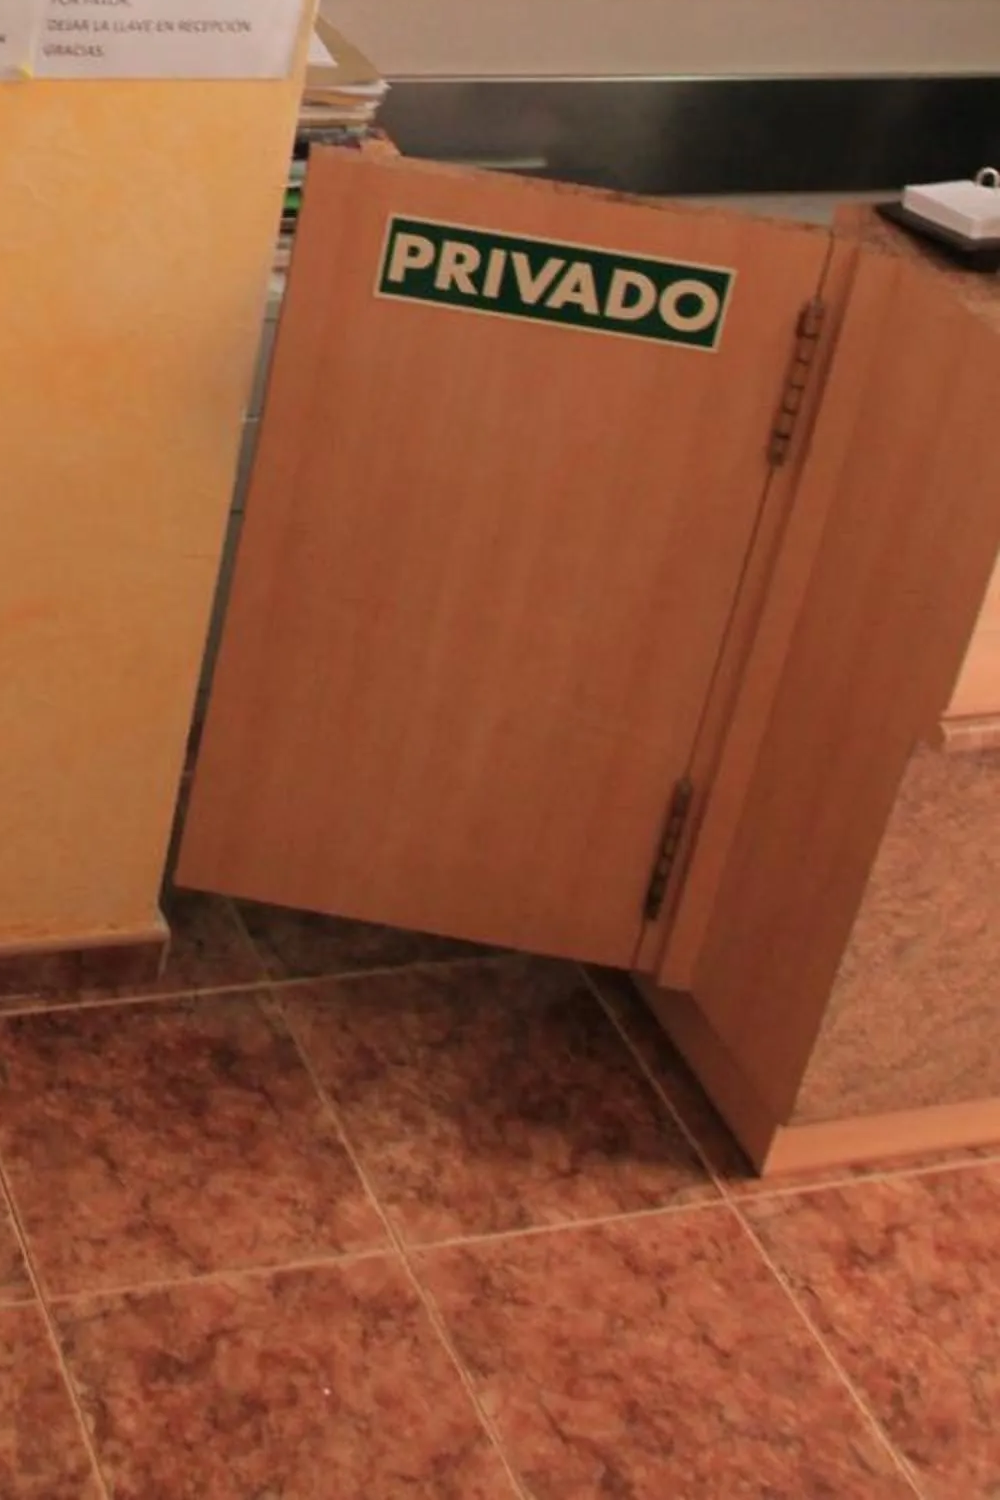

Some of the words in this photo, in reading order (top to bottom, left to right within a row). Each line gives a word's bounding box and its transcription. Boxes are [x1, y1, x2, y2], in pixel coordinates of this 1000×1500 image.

[47, 19, 89, 32] DEJAR
[93, 19, 110, 33] LA
[387, 231, 720, 333] PRIVADO
